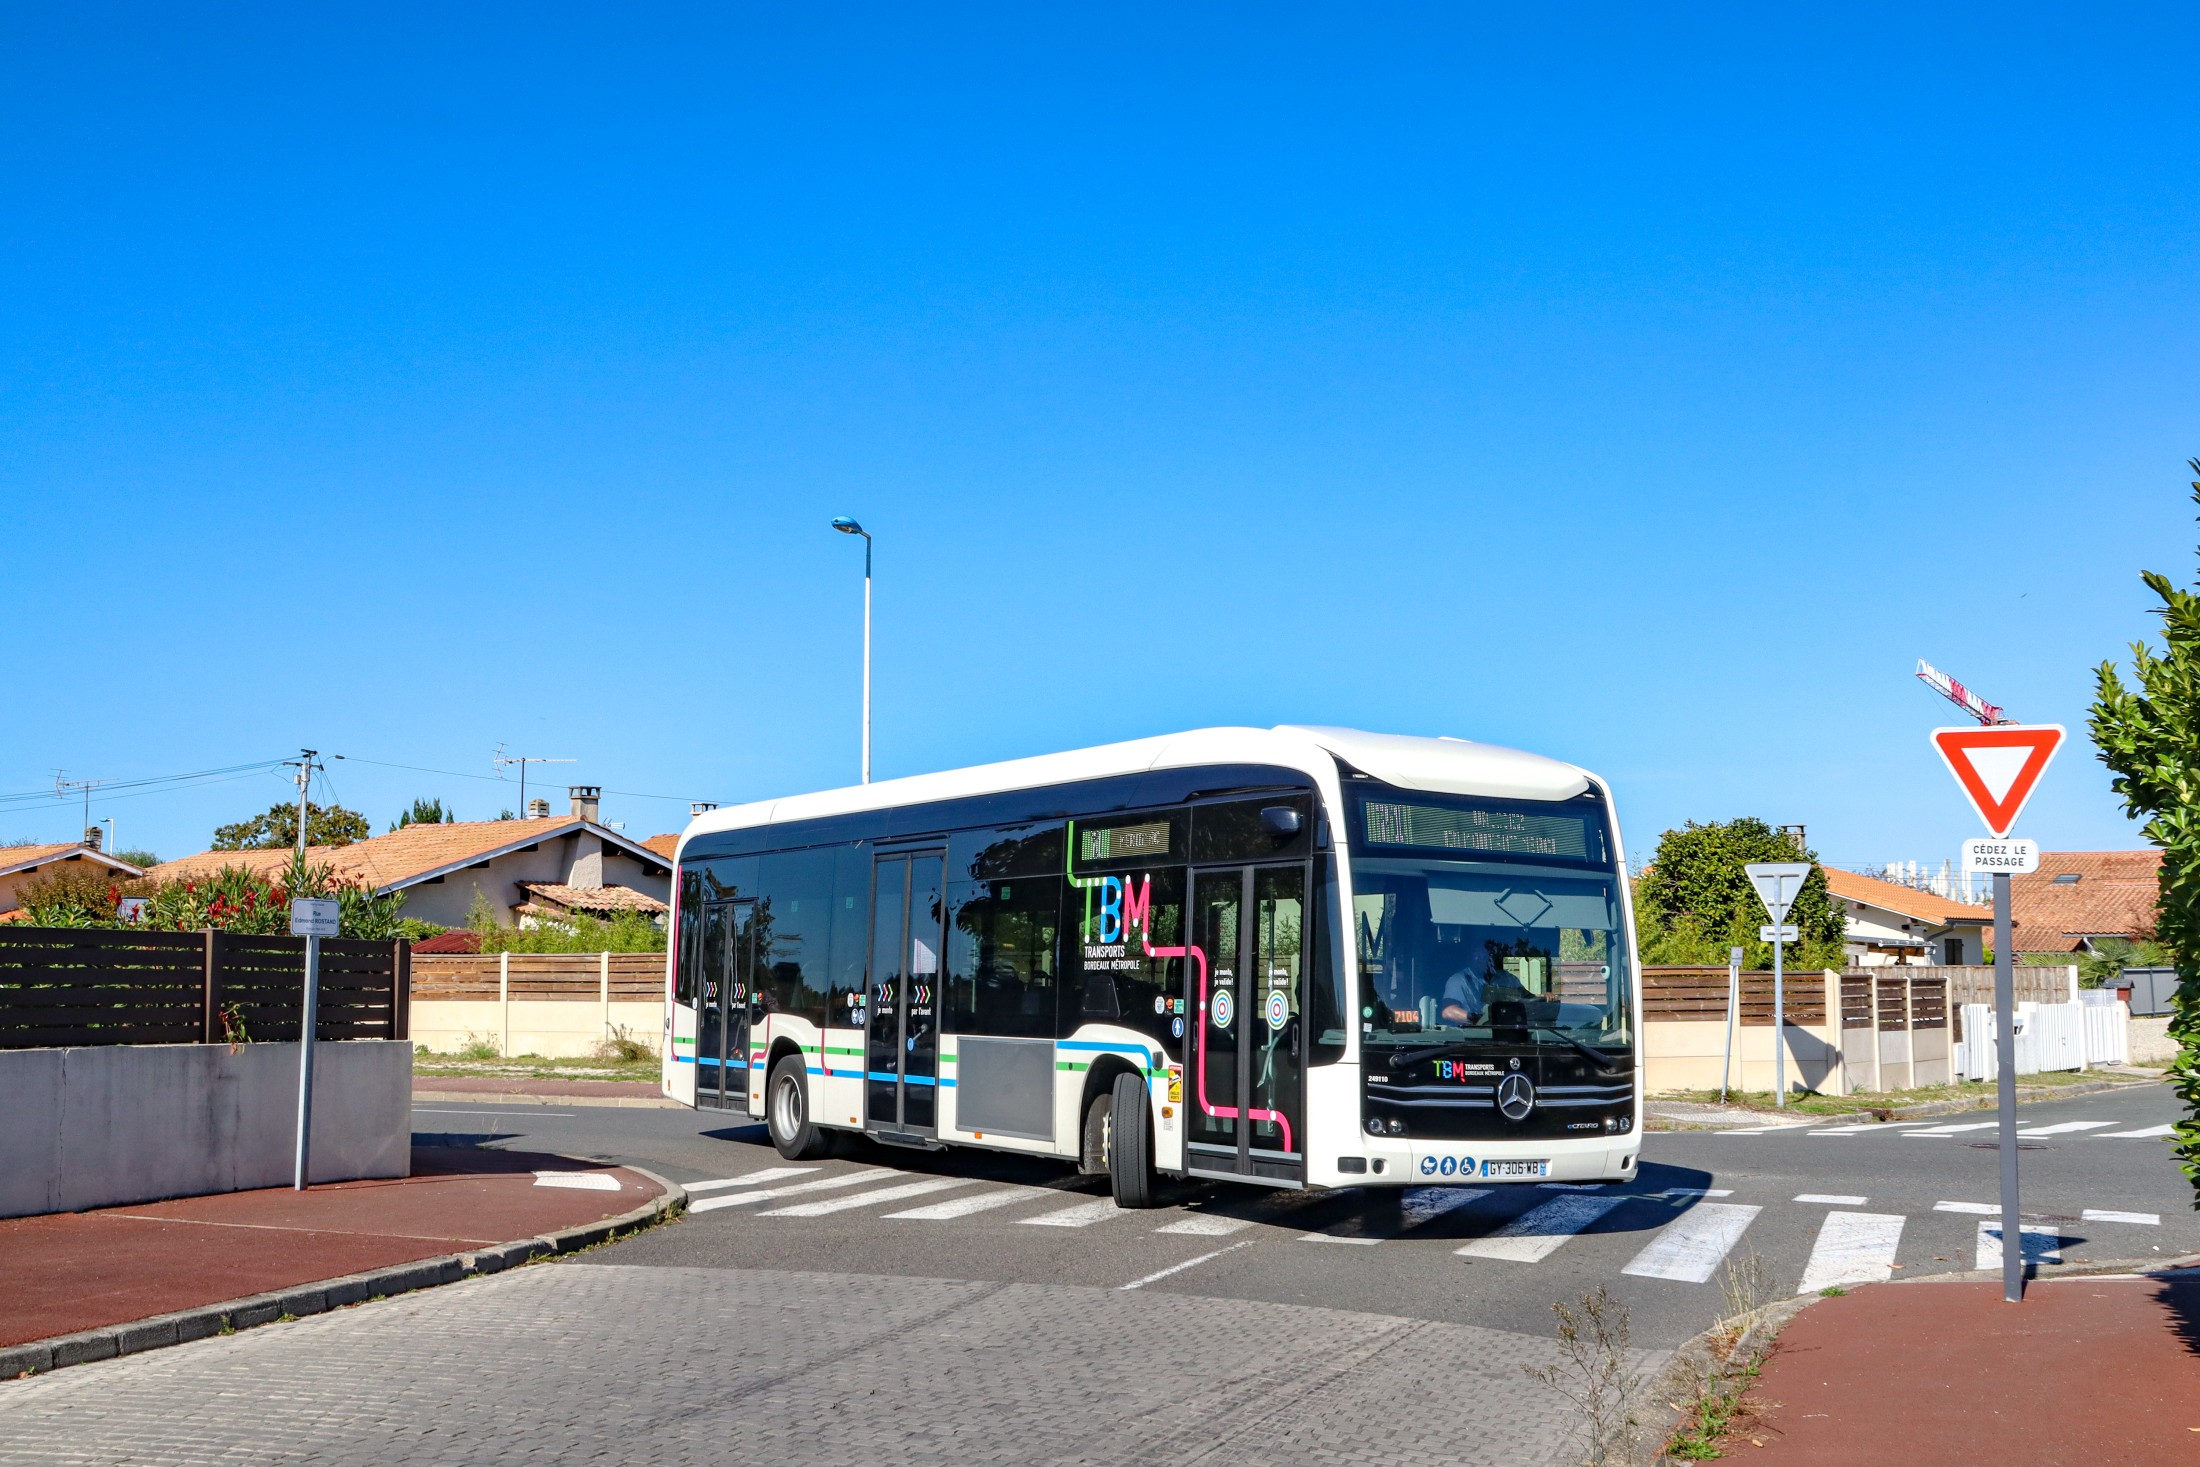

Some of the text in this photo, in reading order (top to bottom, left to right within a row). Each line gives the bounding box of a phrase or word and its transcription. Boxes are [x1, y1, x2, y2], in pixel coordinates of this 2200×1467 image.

[1973, 844, 2027, 855] CÉDEZ LE
[1975, 857, 2024, 867] PASSAGE
[1077, 873, 1150, 944] TBM
[1084, 945, 1125, 958] TRANSPORTS
[1083, 959, 1140, 971] BORDEAUX MÉTROPOLE
[1394, 1010, 1419, 1023] 7104
[1432, 1061, 1465, 1080] TBM
[1490, 1161, 1538, 1175] GY-306-WB
